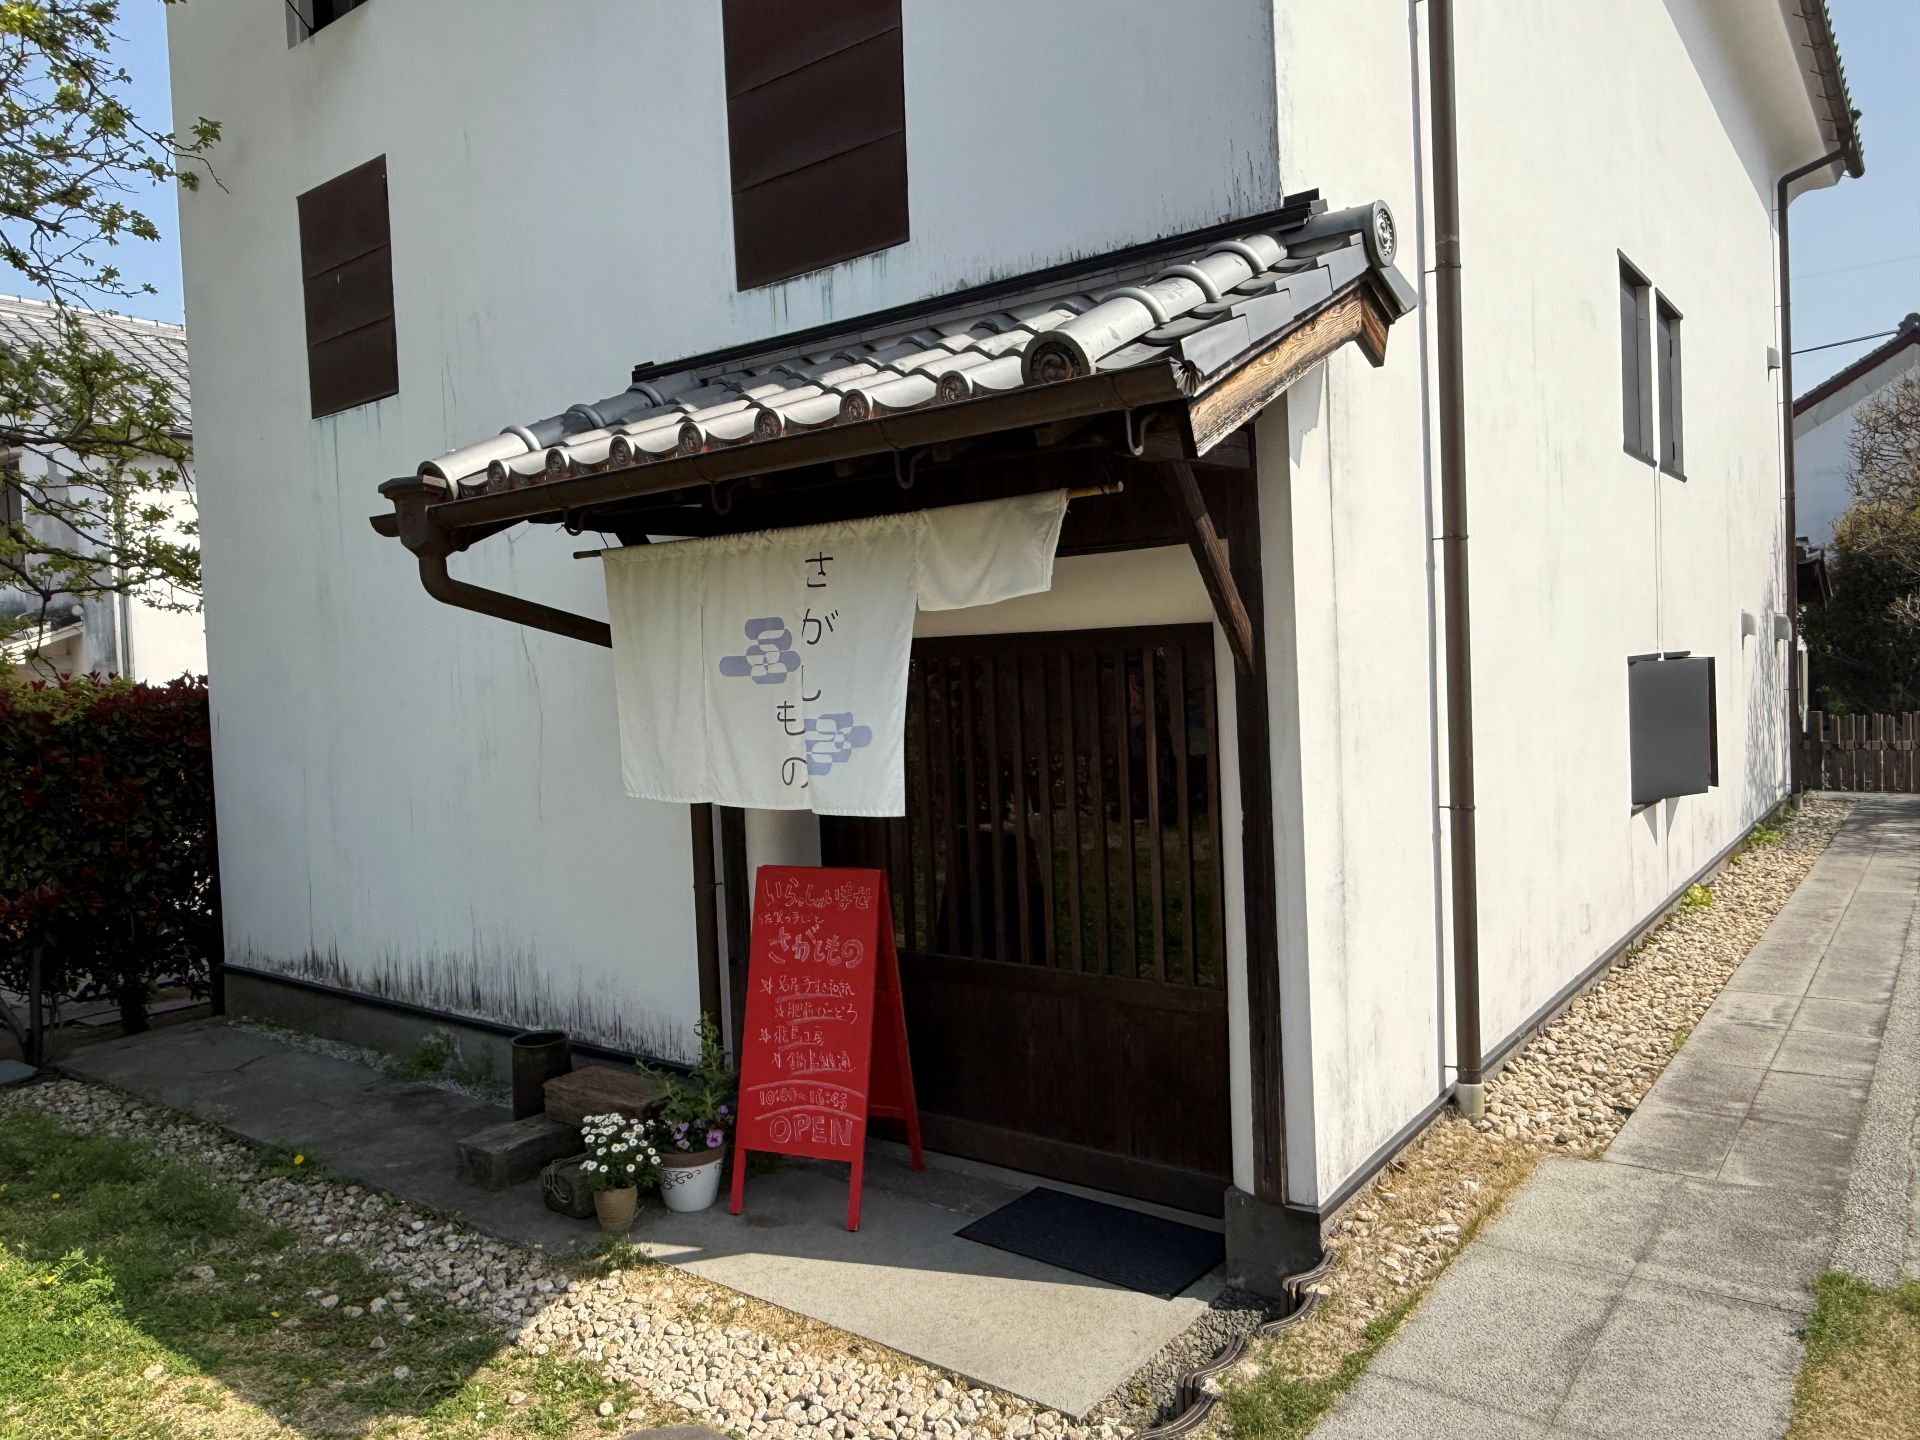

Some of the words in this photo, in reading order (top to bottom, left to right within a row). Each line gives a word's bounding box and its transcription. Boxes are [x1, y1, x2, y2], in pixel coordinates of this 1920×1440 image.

[777, 551, 838, 788] さがしもの
[764, 877, 873, 911] いらっしゃいませ
[768, 924, 864, 968] さがしもの
[769, 1113, 853, 1146] OPEN
